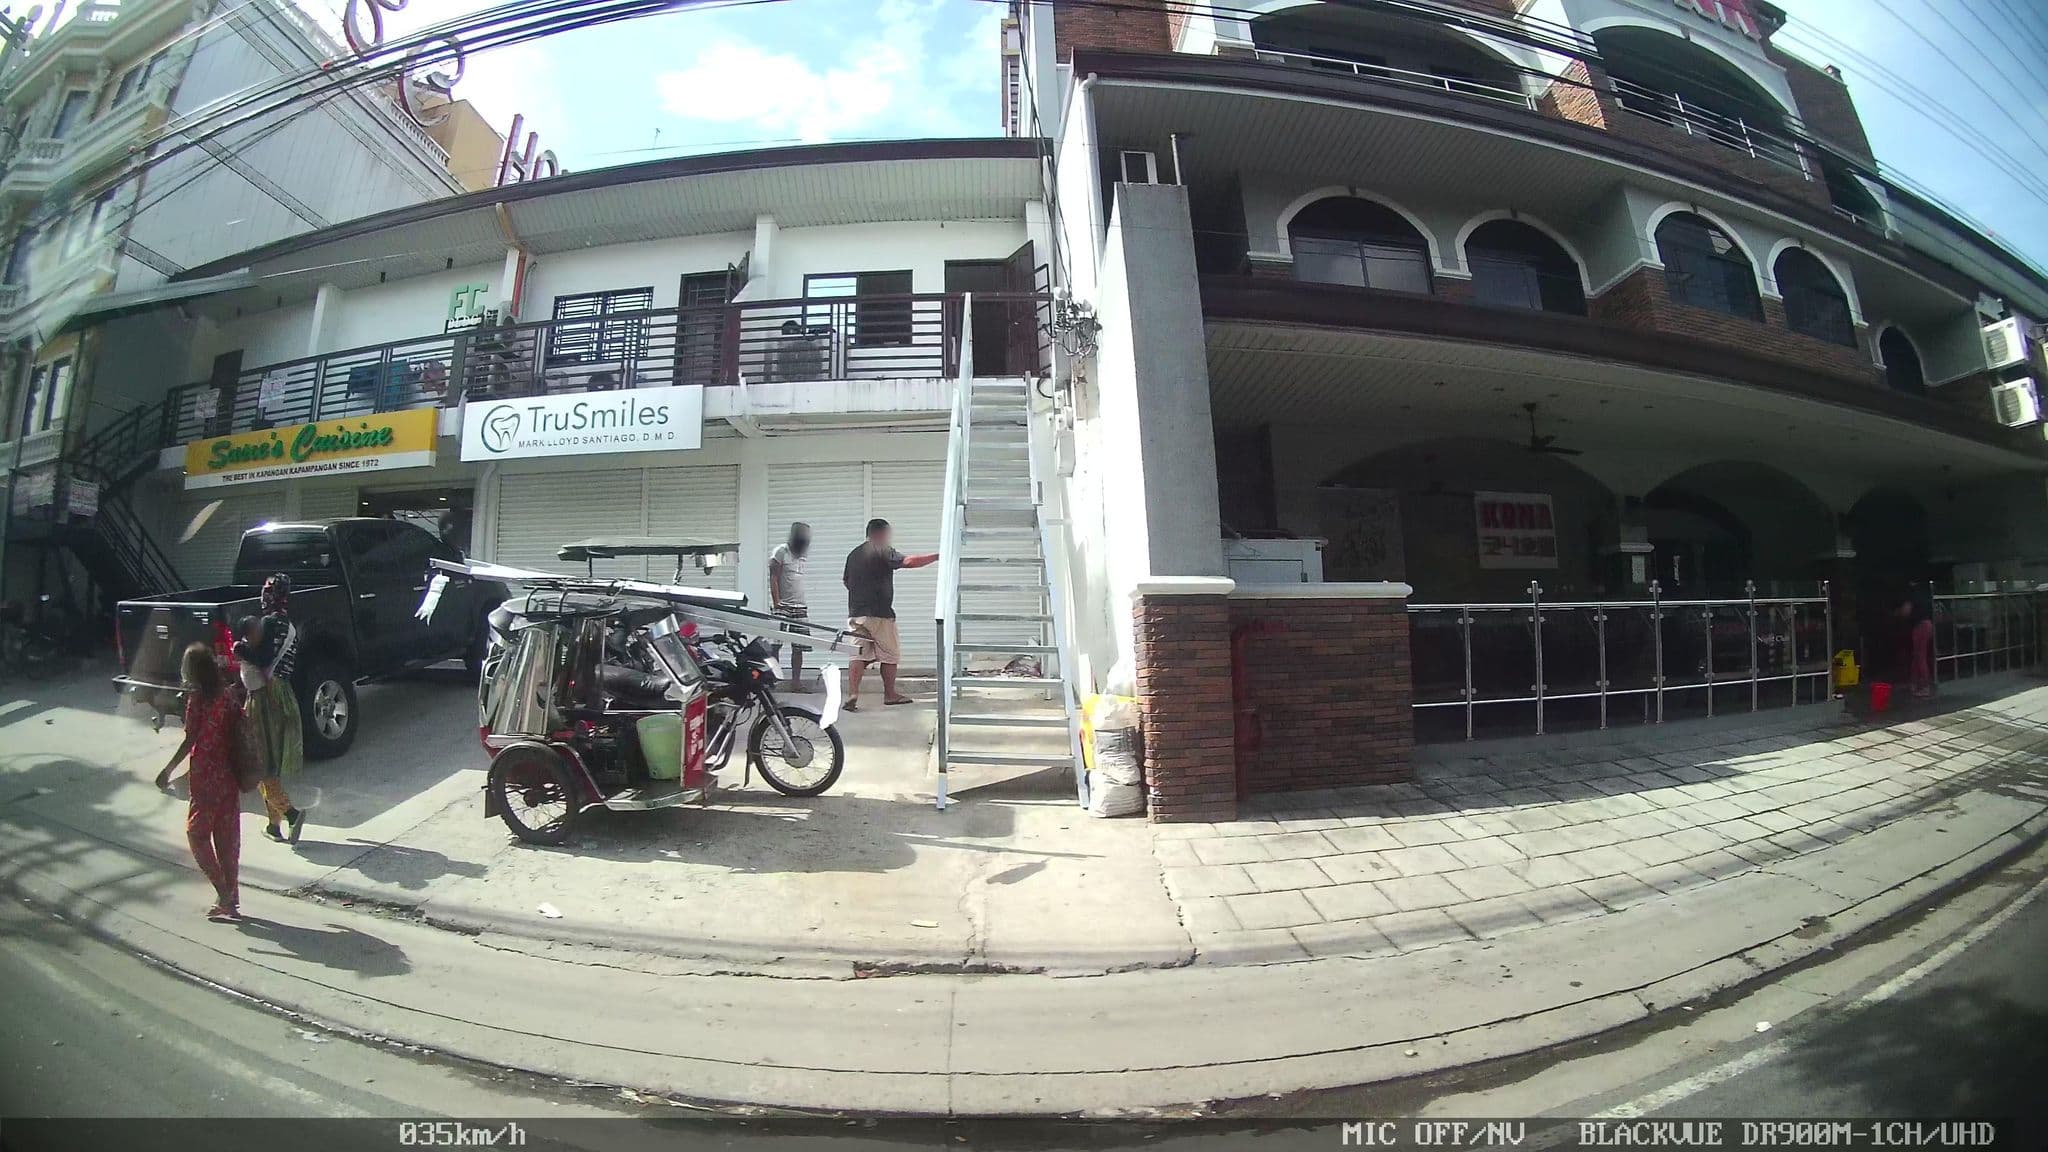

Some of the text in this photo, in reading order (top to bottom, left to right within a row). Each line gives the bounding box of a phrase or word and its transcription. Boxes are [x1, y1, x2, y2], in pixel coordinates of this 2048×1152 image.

[527, 397, 669, 433] TruSmiles
[290, 423, 393, 461] Cuisine
[518, 439, 545, 449] MARK
[548, 436, 580, 447] LLOYD
[234, 473, 248, 481] BEST
[289, 462, 338, 476] KAPAMPANGAN
[338, 460, 360, 470] SINCE
[362, 458, 379, 468] 1972
[1481, 502, 1553, 530] KONA
